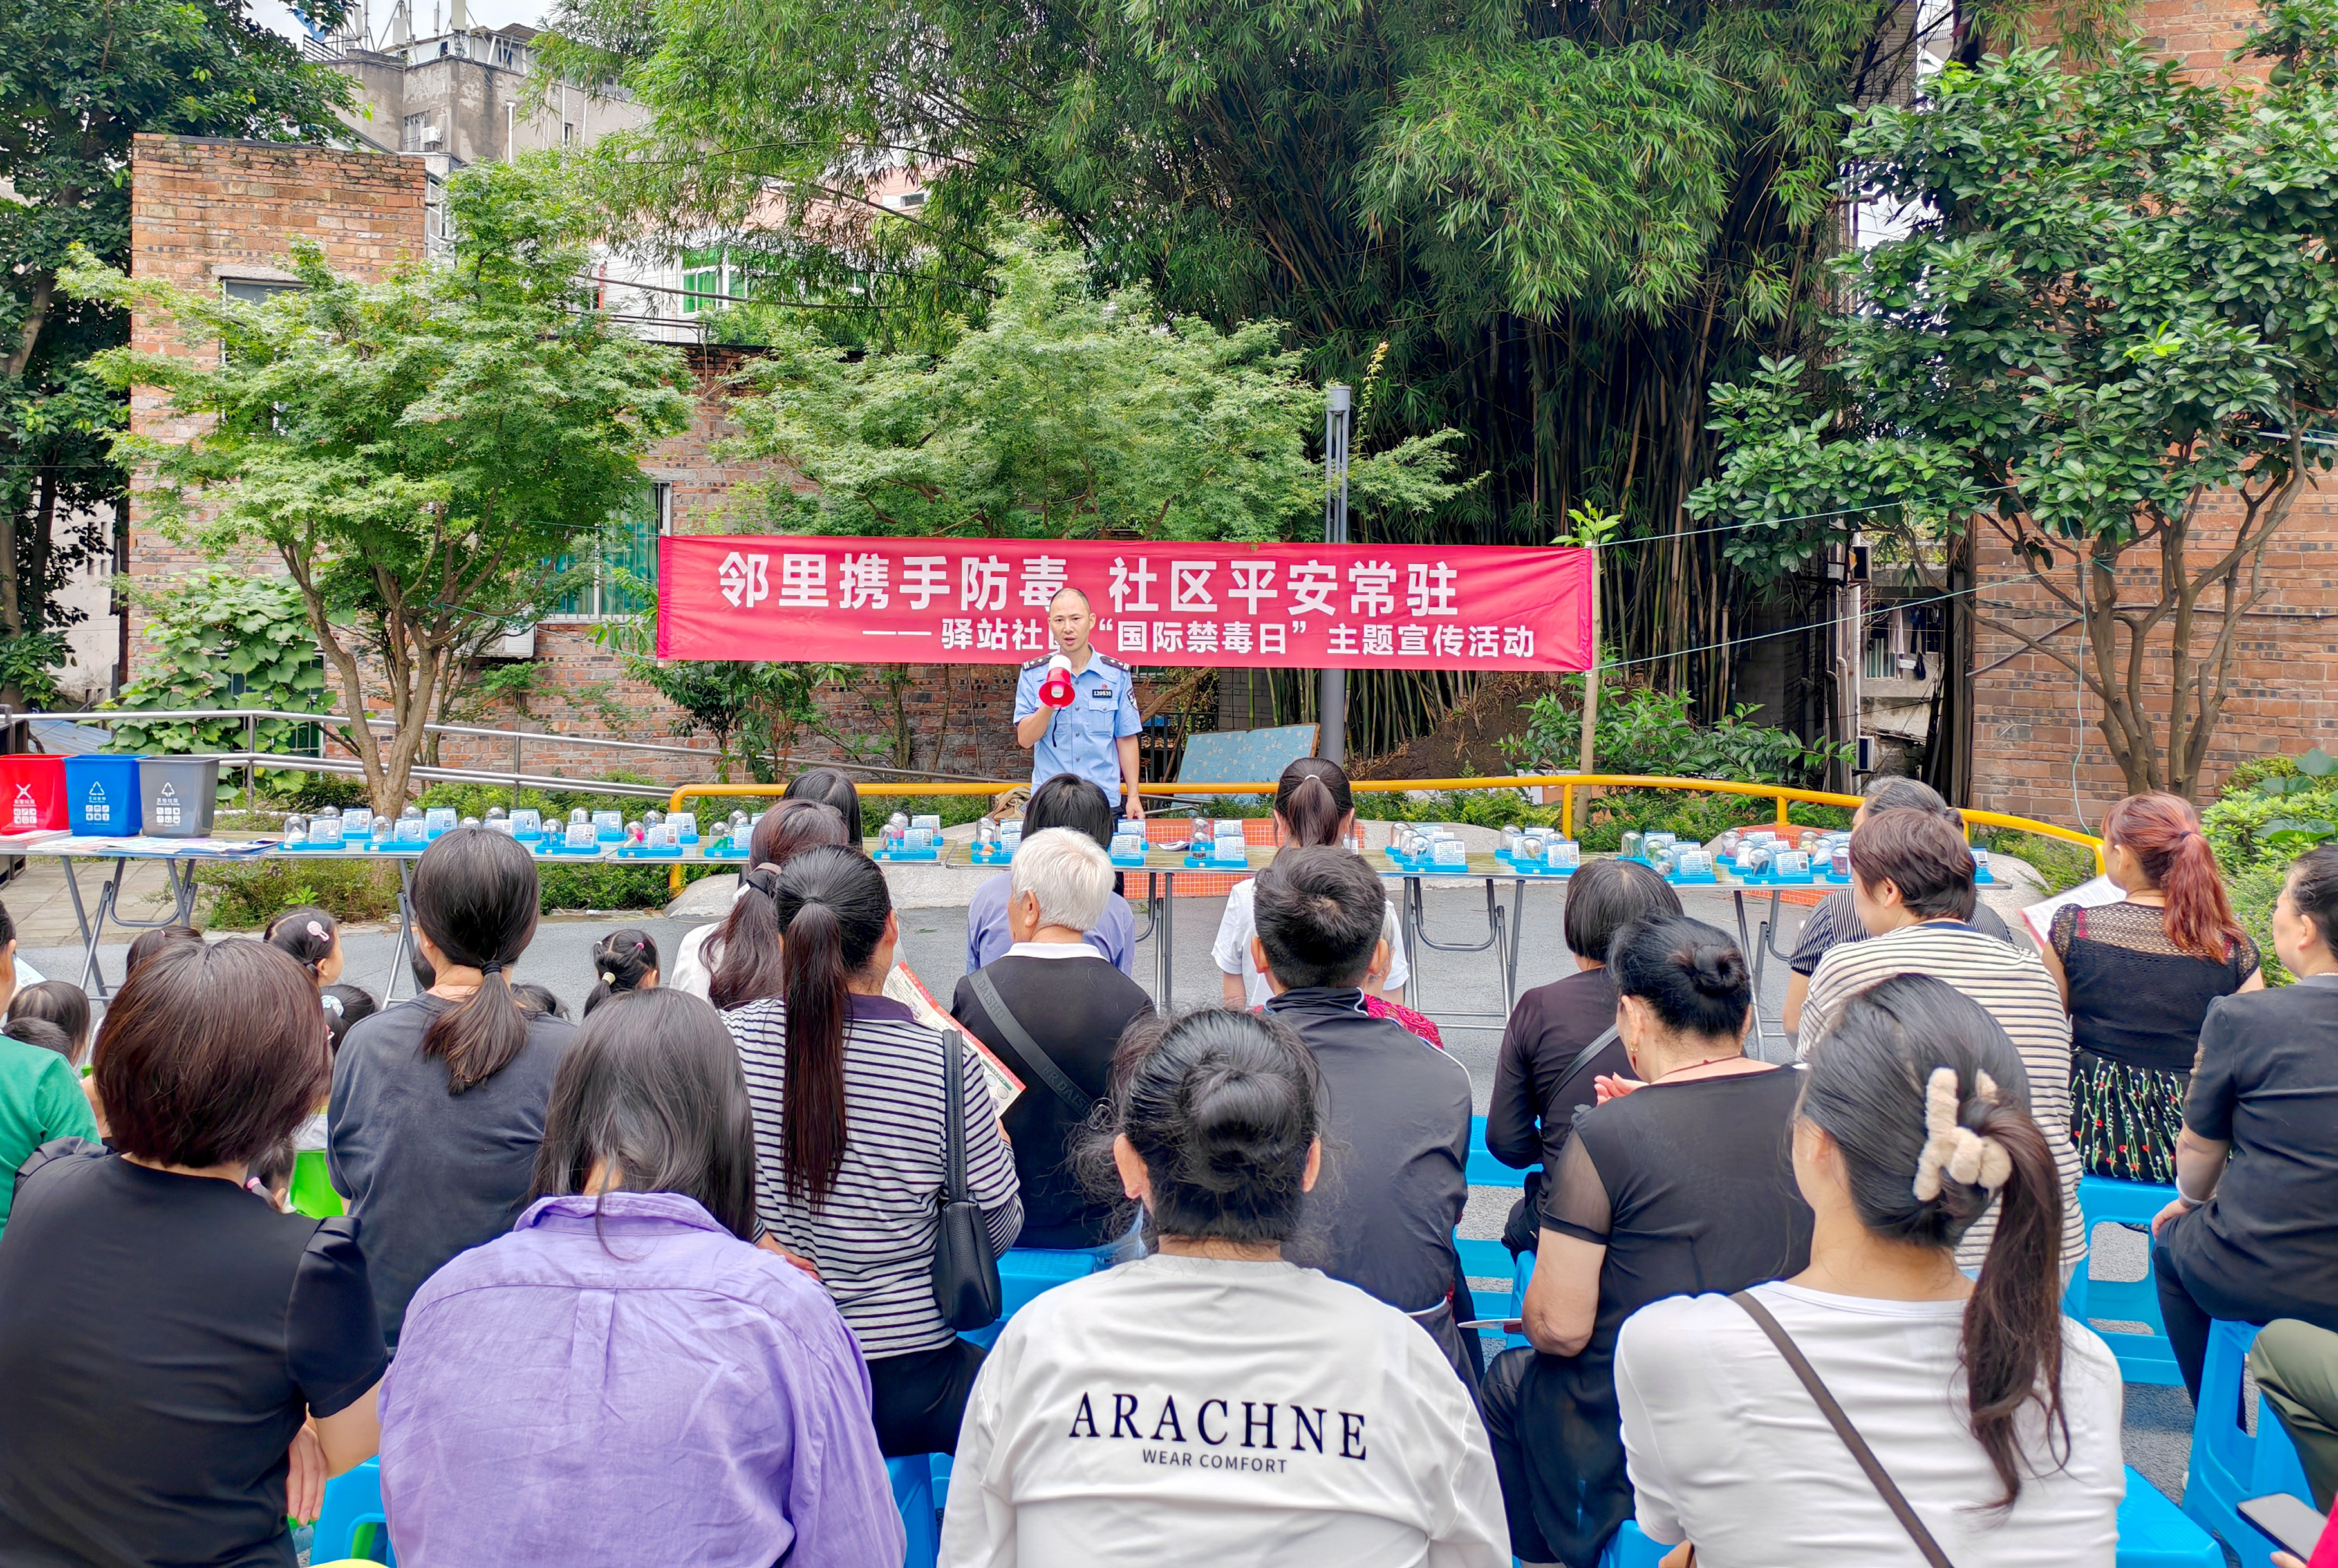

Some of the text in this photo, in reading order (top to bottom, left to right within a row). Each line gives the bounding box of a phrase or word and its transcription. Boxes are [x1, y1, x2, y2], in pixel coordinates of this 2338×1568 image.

[718, 551, 1459, 617] 邻里携手防毒 社区平安常驻
[1069, 1391, 1367, 1461] ARACHNE
[1142, 1448, 1287, 1474] WEAR COMFORT
